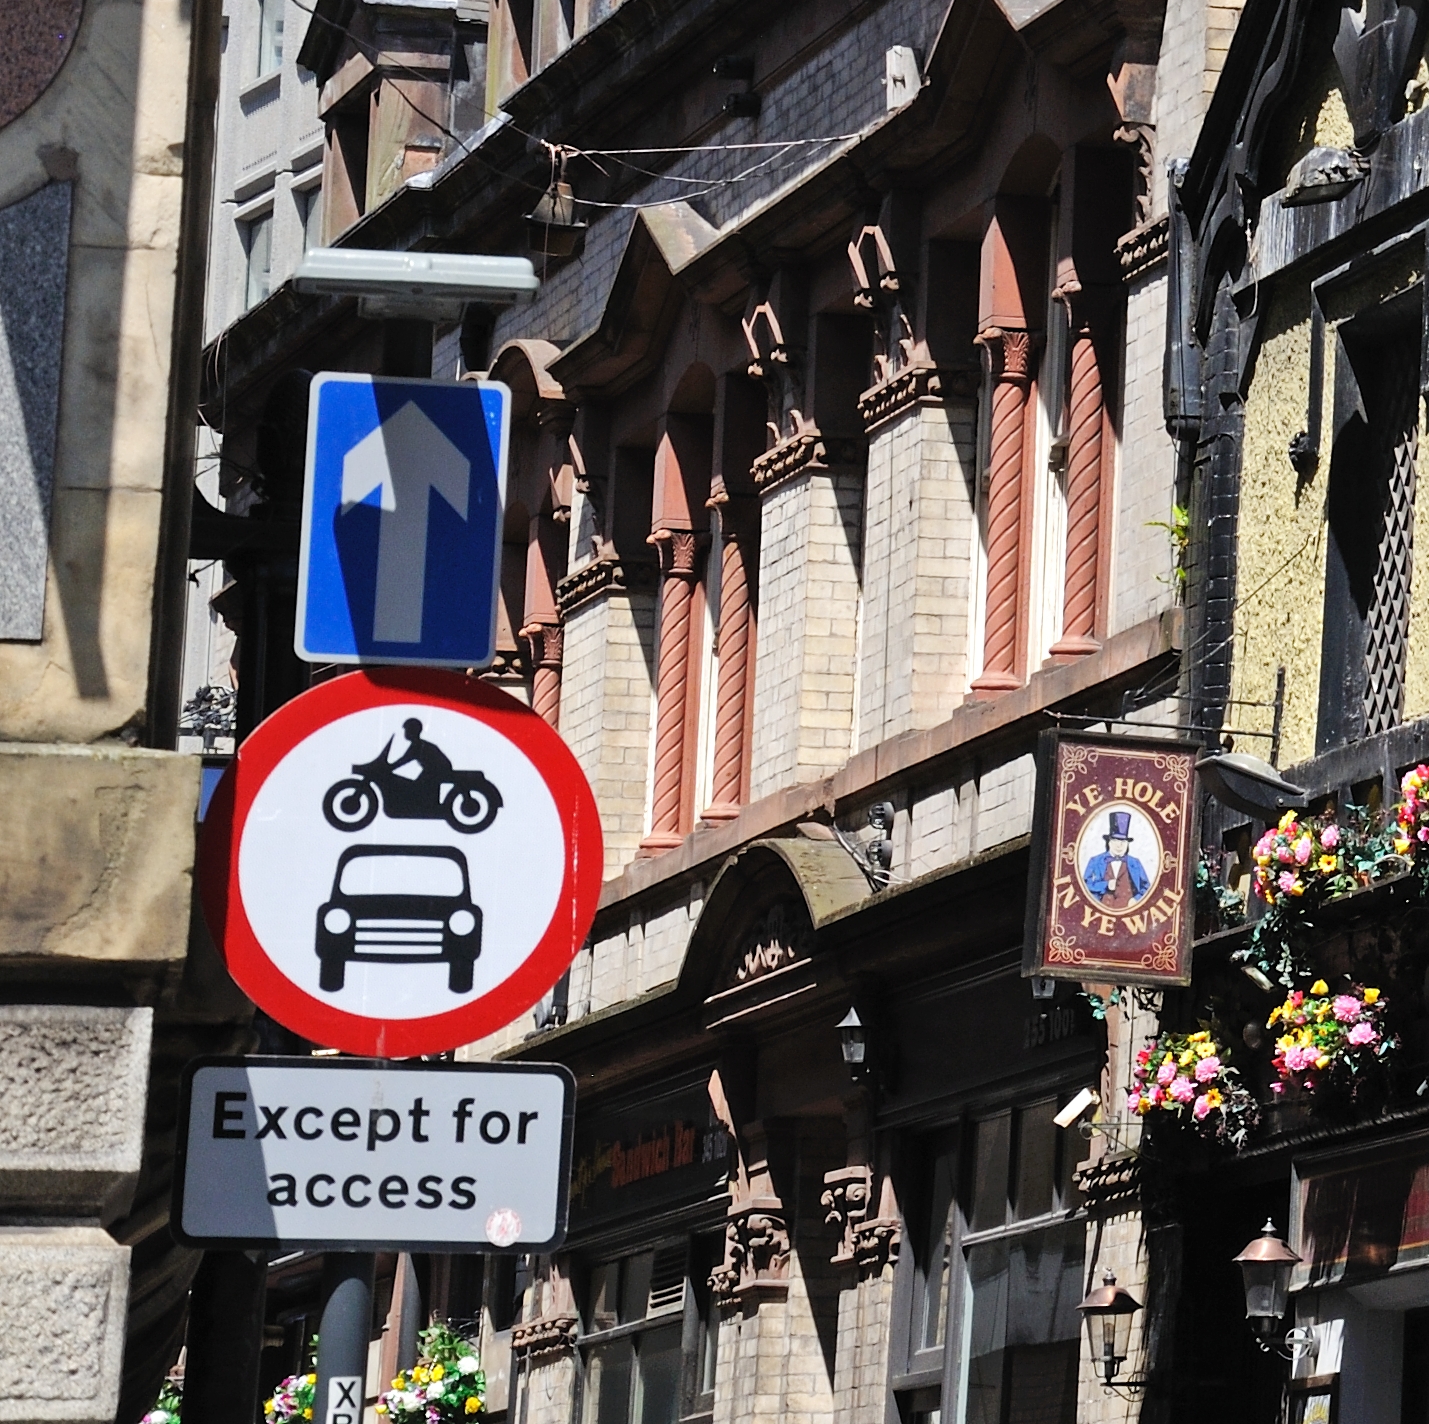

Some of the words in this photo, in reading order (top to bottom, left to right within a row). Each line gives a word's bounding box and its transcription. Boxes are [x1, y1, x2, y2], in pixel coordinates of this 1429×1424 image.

[1066, 785, 1103, 816] YE
[1114, 778, 1180, 823] HOLE
[1054, 877, 1080, 908] IN
[1081, 907, 1115, 936] YE
[1122, 889, 1184, 935] WALL
[213, 1091, 430, 1151] Except
[452, 1097, 539, 1145] for
[266, 1173, 477, 1210] access
[335, 1381, 356, 1409] X
